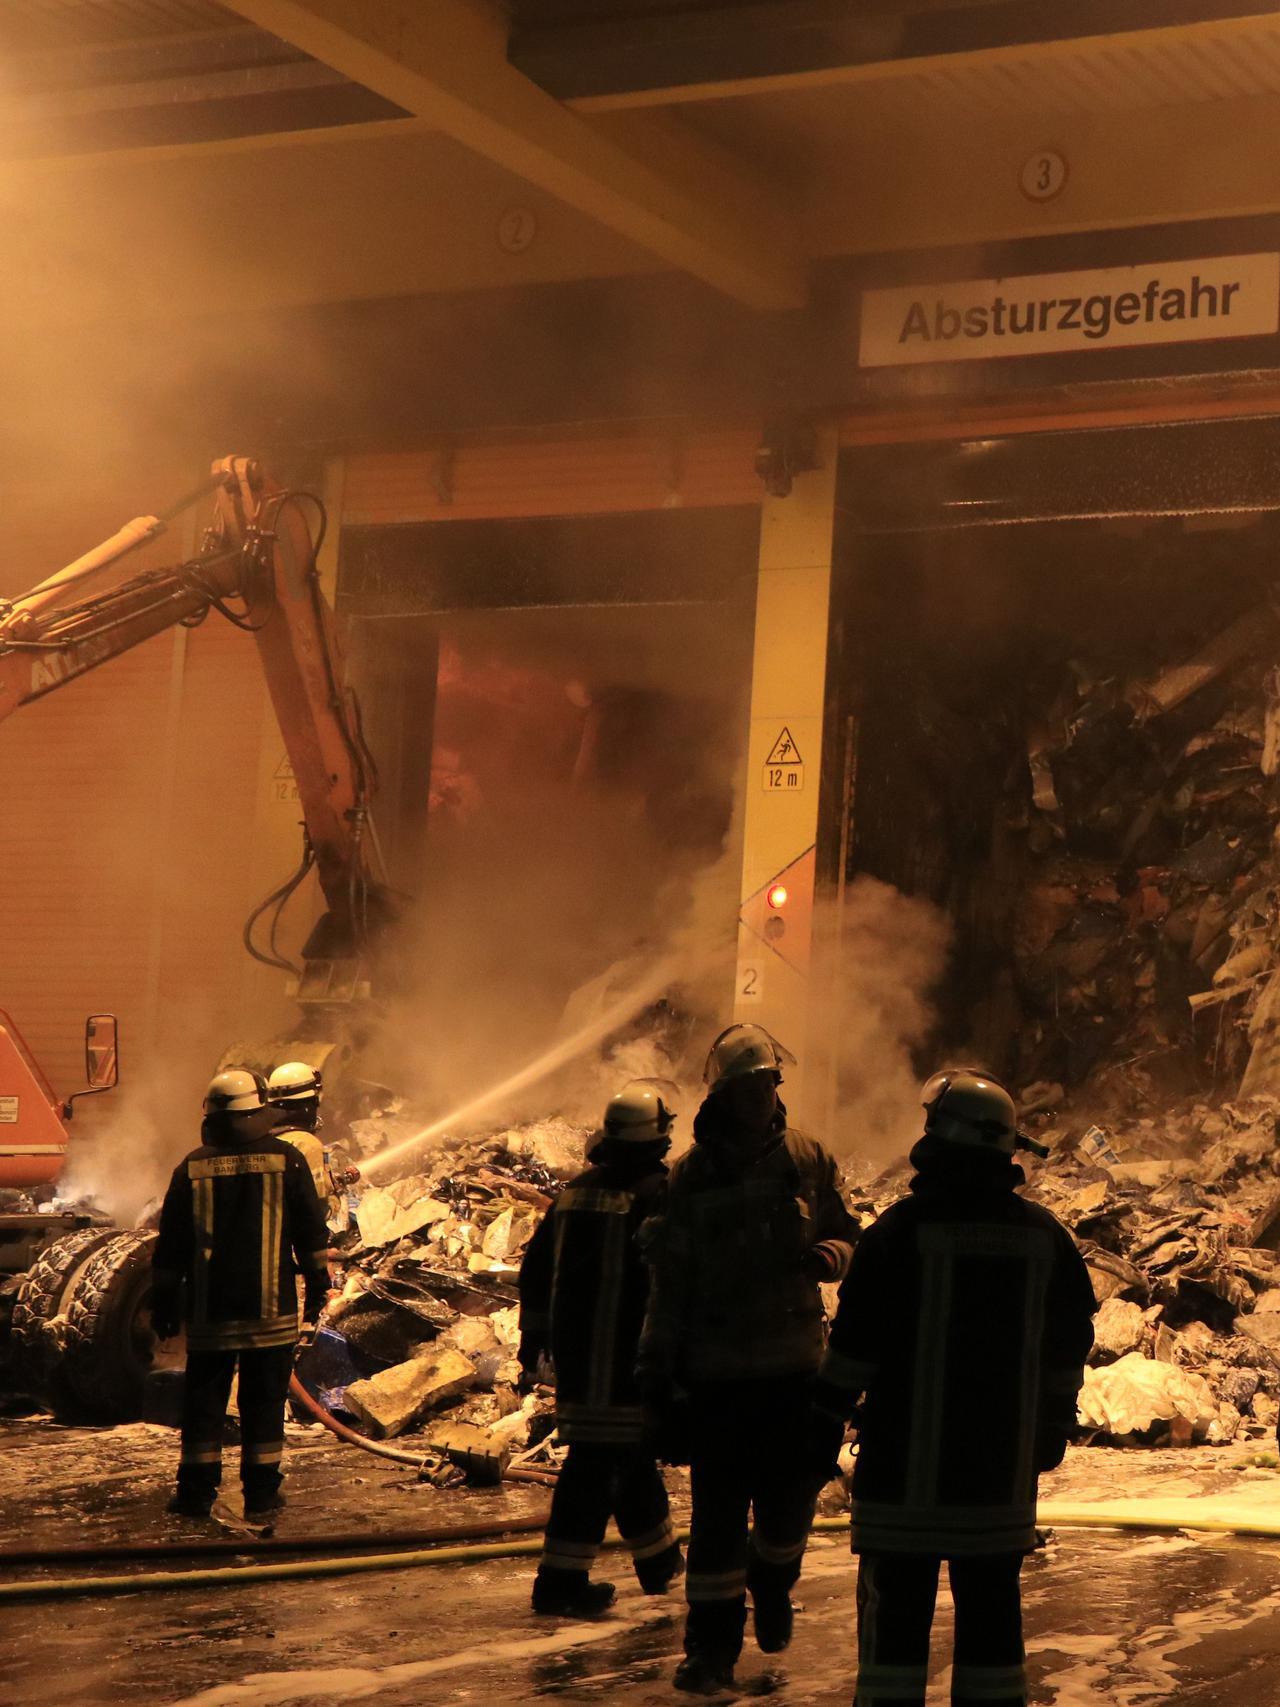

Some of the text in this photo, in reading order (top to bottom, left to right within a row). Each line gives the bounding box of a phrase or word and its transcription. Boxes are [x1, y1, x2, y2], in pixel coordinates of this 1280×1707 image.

[1037, 158, 1052, 191] 3
[898, 276, 1240, 344] Absturzgefahr
[769, 769, 798, 787] 12 m
[743, 967, 758, 995] 2
